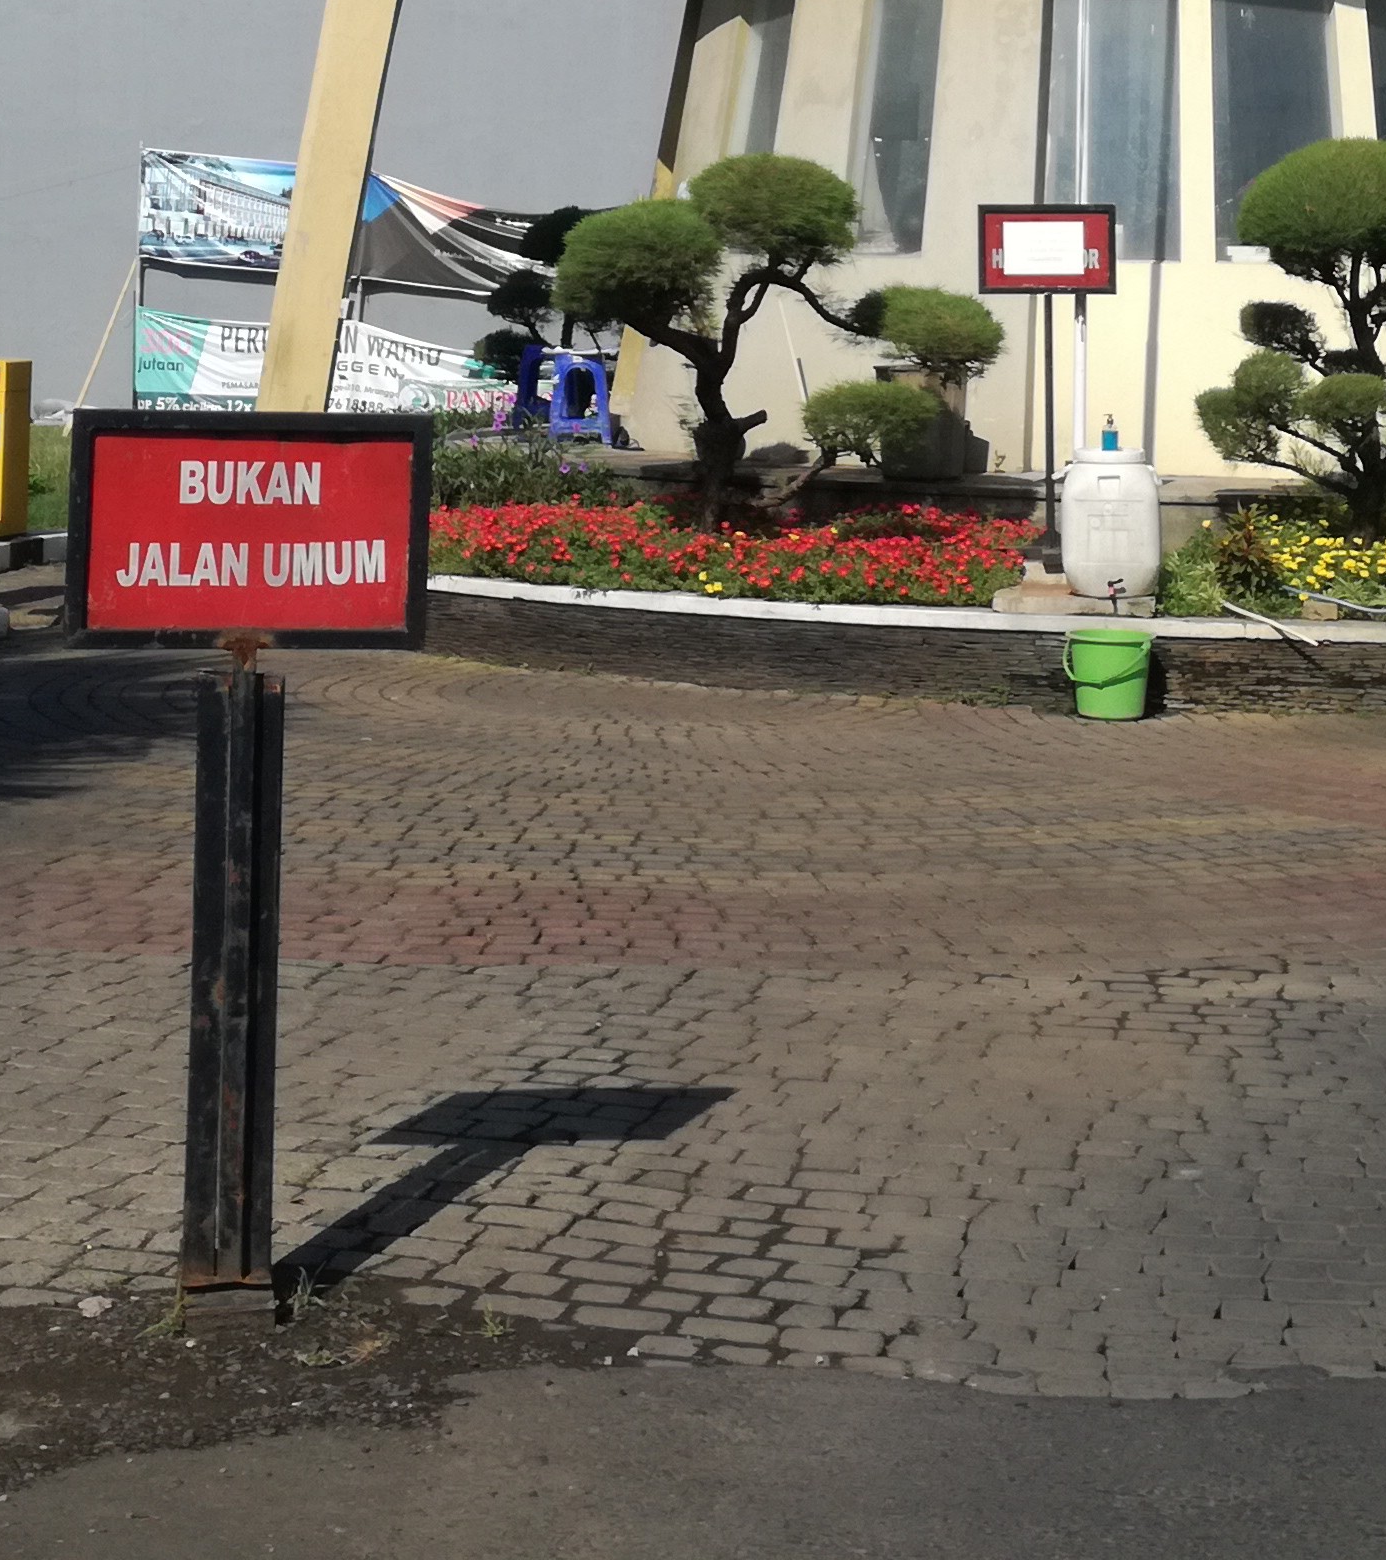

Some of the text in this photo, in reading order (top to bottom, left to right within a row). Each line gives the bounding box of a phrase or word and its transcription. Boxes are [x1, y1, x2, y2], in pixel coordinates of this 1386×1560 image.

[137, 357, 185, 373] jutaan
[137, 399, 153, 411] DP
[155, 396, 180, 411] 5%
[179, 460, 321, 506] BUKAN
[116, 540, 386, 587] JALAN UMUM
